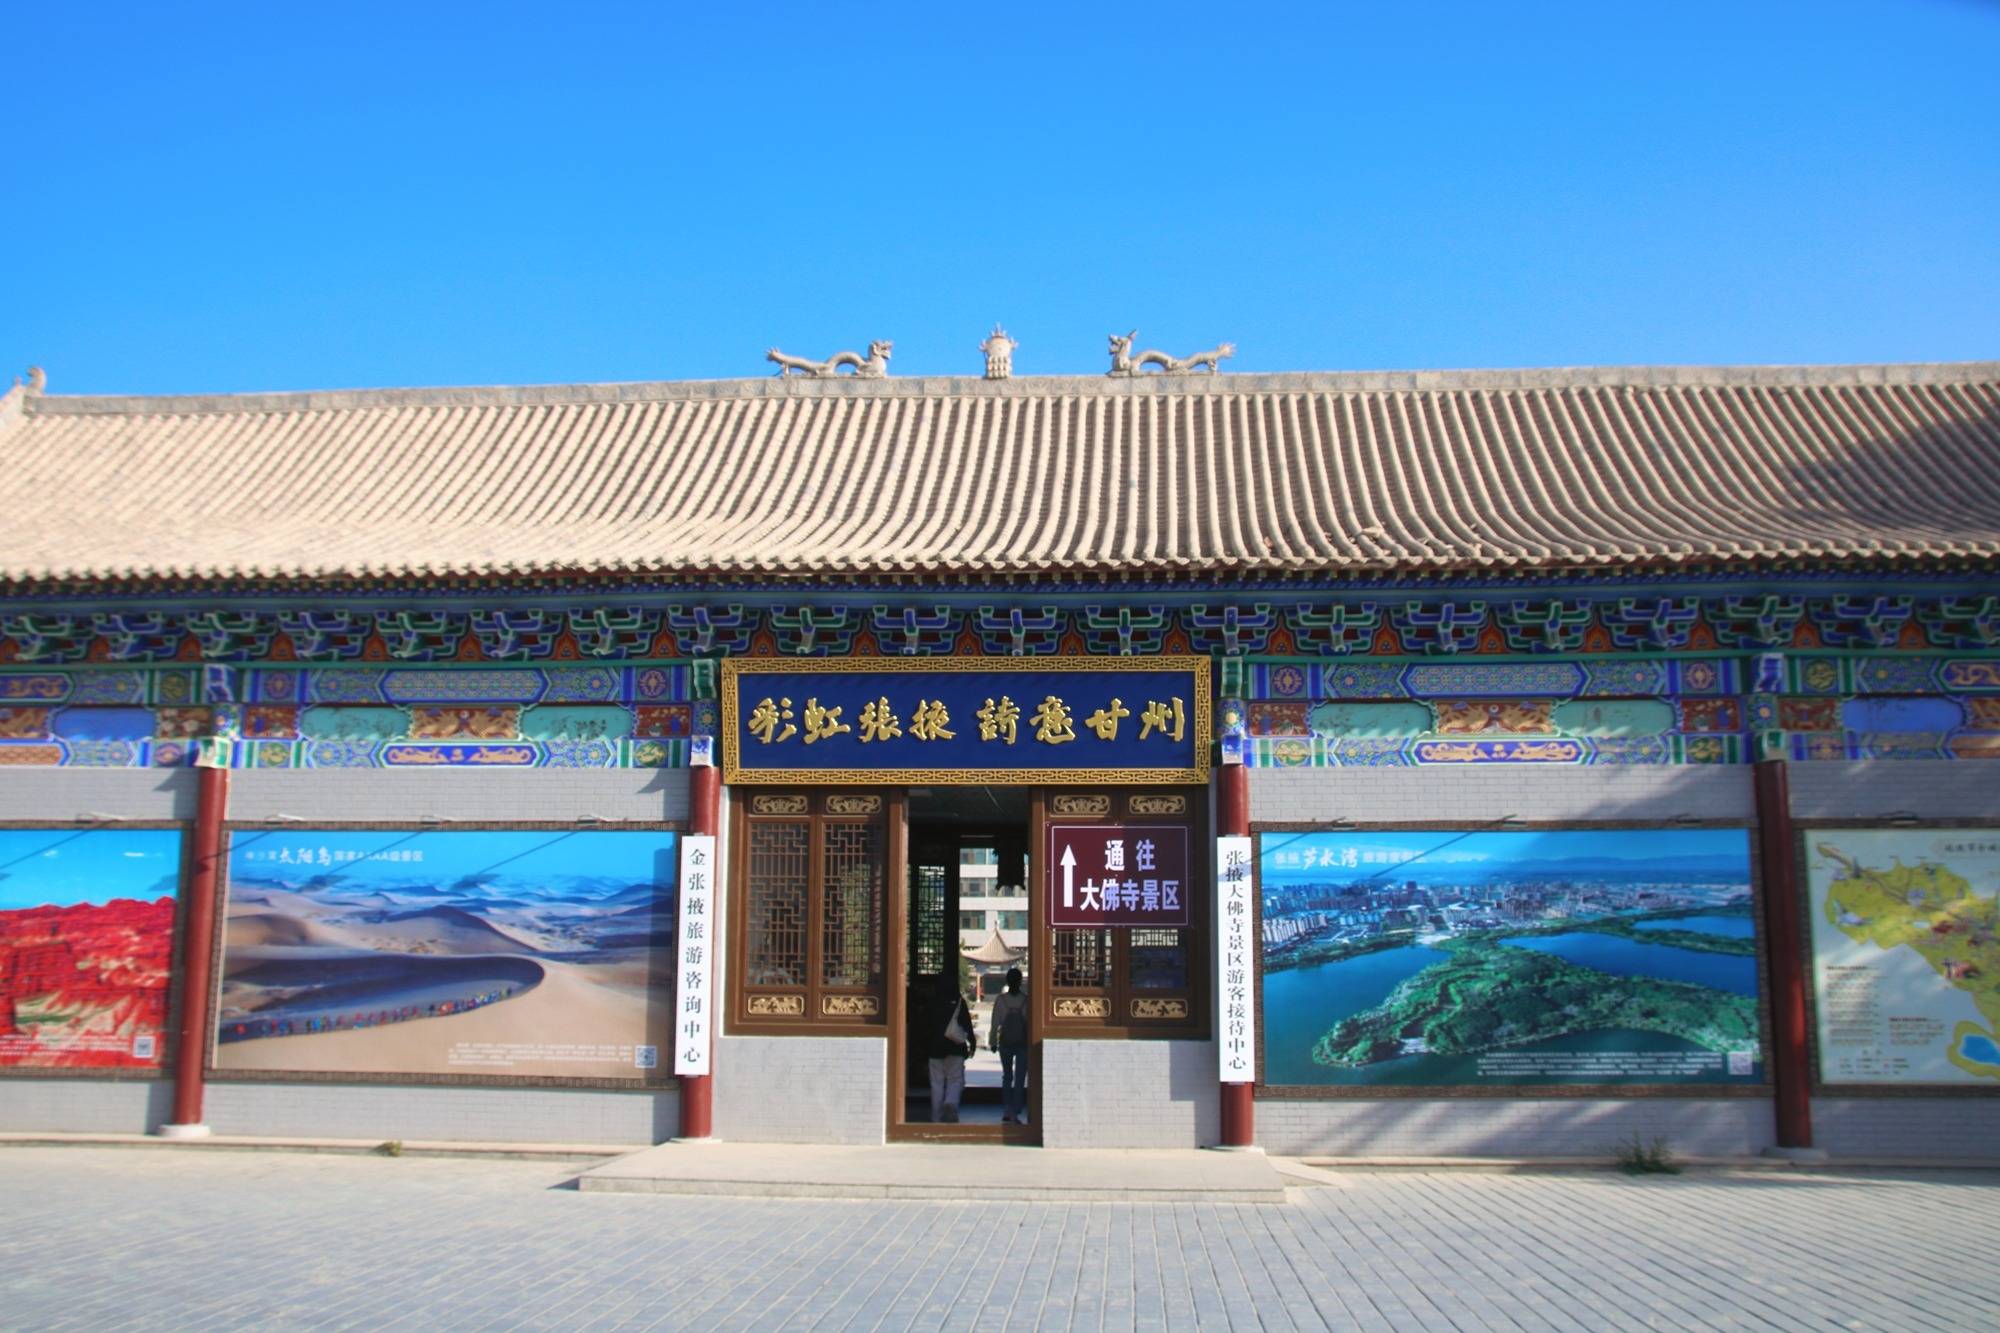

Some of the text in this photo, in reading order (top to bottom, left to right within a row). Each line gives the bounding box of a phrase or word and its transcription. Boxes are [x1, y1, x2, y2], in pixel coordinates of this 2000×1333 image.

[1080, 878, 1180, 911] 大佛寺景区
[1104, 839, 1156, 872] 通往
[683, 848, 706, 1063] 金张掖旅游咨询中心
[1225, 850, 1246, 1070] 张掖大佛寺景区游客接待中心
